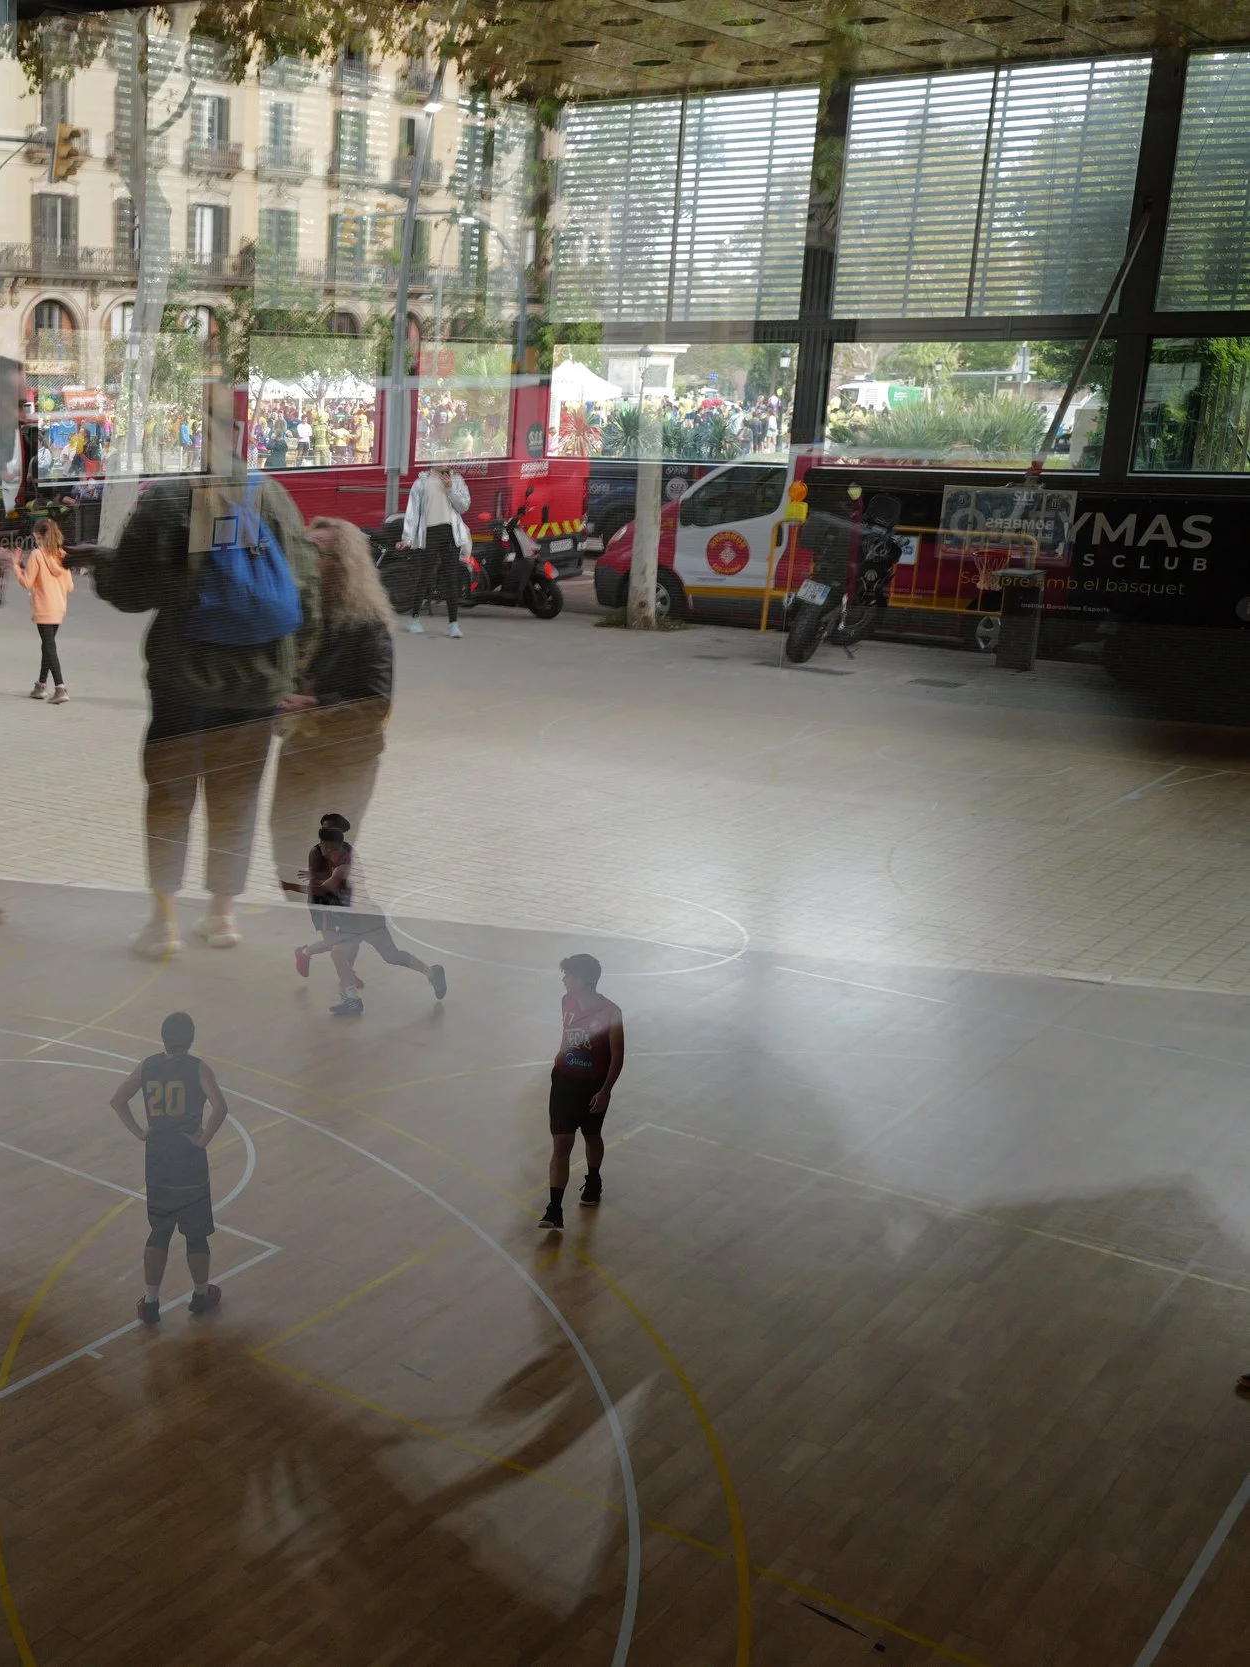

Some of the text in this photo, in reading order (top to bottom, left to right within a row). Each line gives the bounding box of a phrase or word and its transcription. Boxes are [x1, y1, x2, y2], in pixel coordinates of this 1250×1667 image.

[1111, 555, 1208, 571] CLUB
[1035, 575, 1078, 591] amb
[1083, 577, 1099, 591] el
[1105, 577, 1187, 597] bàsquet
[146, 1081, 185, 1117] 20
